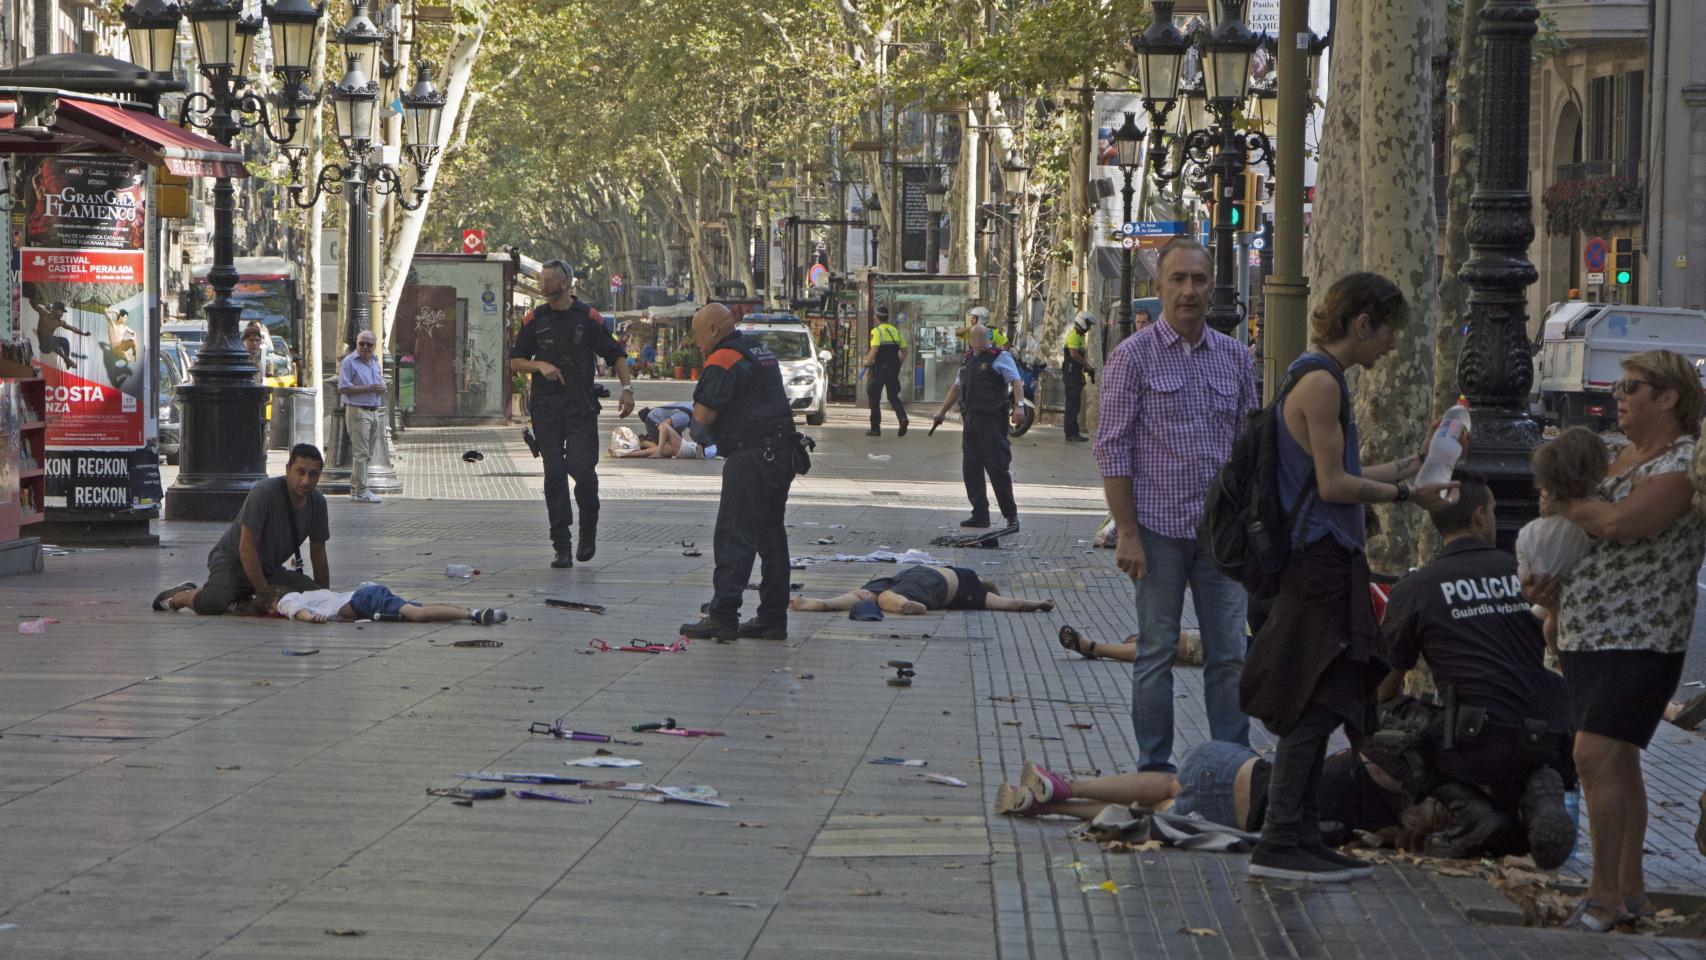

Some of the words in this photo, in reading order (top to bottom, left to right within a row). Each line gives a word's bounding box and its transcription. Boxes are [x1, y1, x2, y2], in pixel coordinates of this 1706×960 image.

[43, 194, 136, 222] FLAMENCO
[48, 255, 91, 264] FESTIVAL
[48, 264, 87, 273] CASTELL
[90, 265, 134, 274] PERALADA
[77, 457, 128, 476] RECKON
[75, 486, 127, 504] RECKON
[1440, 574, 1521, 605] POLICIA
